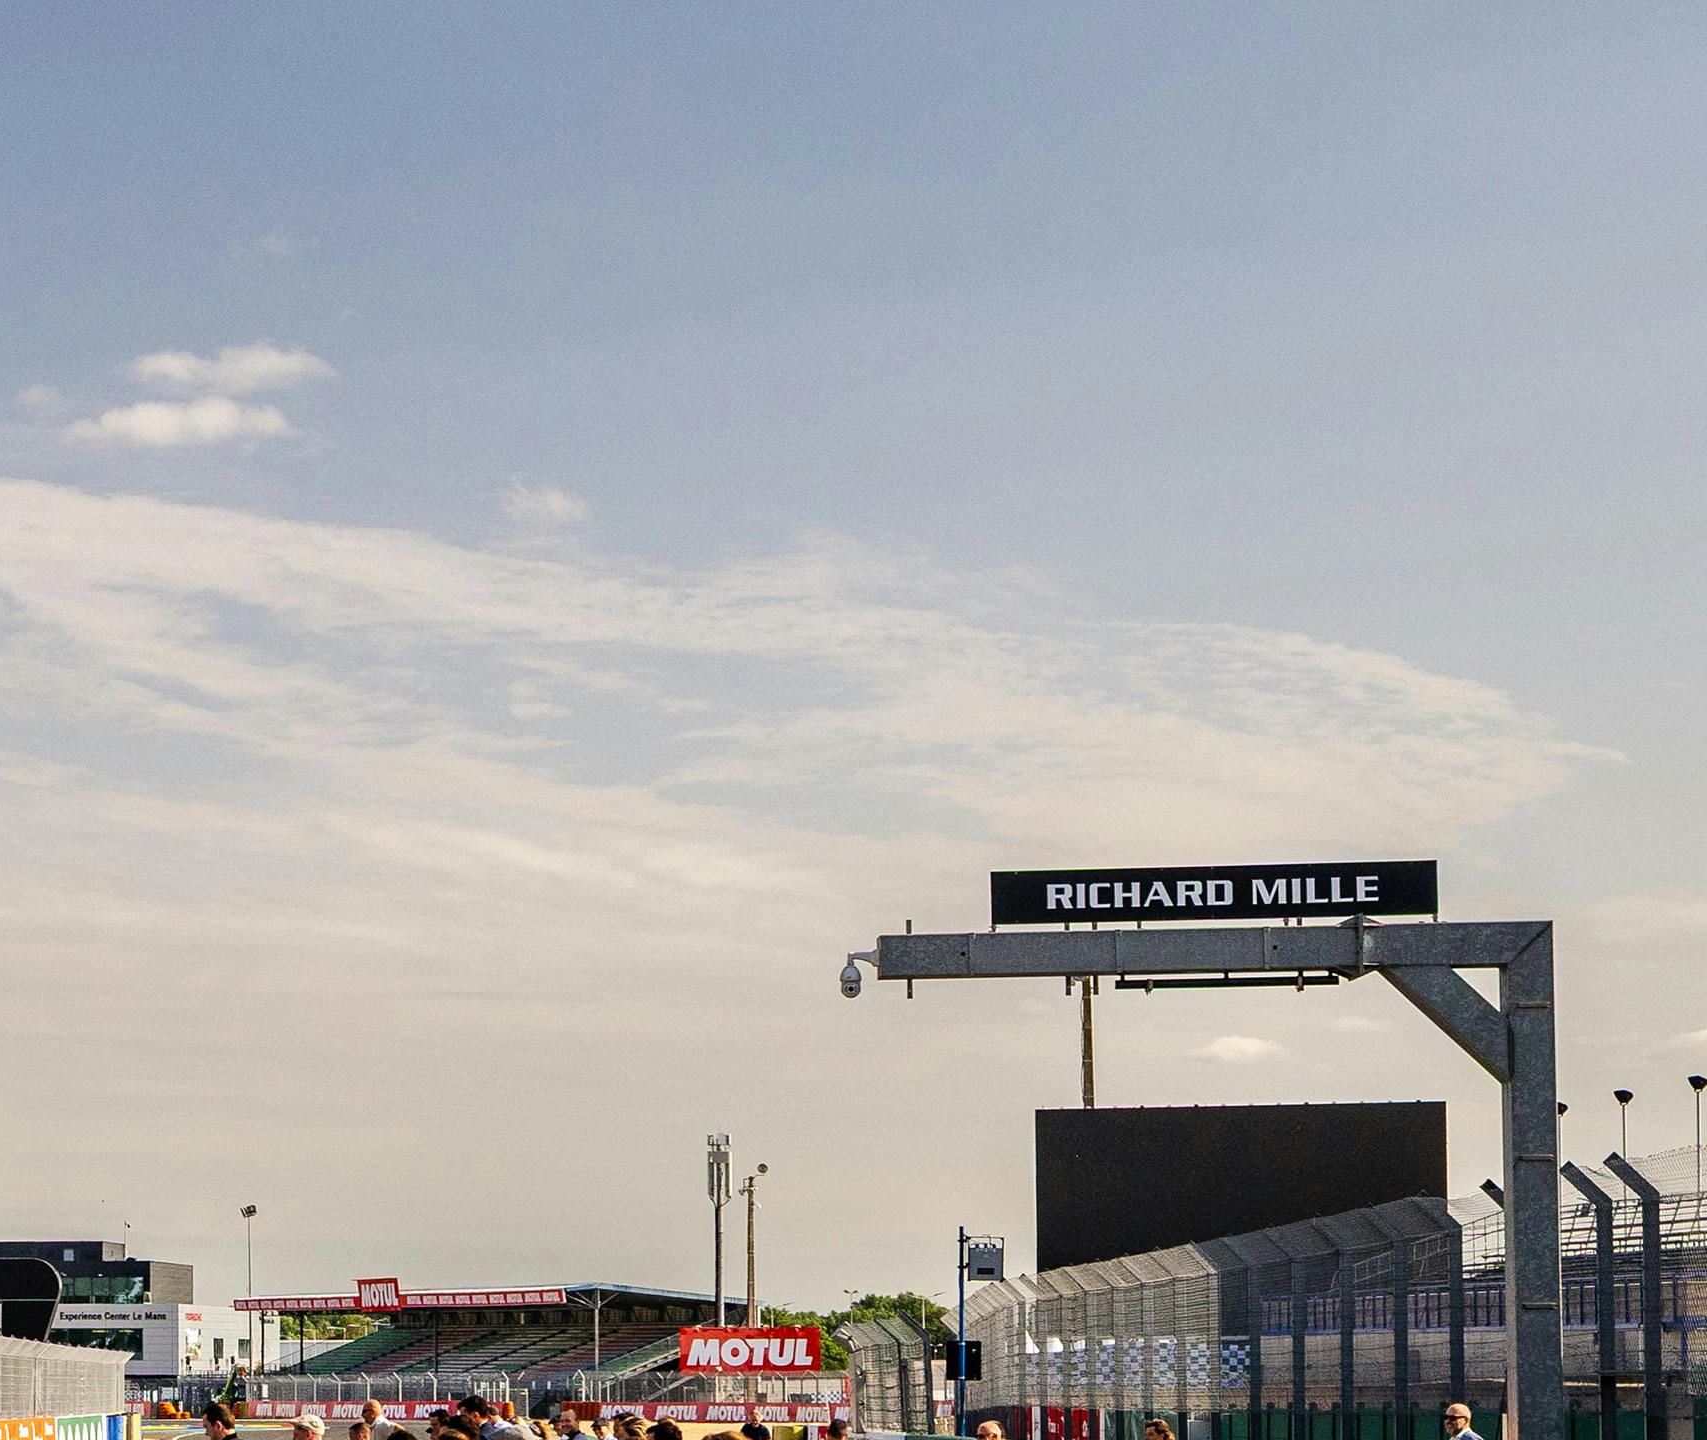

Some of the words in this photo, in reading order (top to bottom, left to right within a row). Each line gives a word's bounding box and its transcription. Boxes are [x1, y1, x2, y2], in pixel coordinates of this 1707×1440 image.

[1046, 880, 1233, 910] RICHARD
[1252, 876, 1379, 905] MILLE
[361, 1283, 398, 1307] MOTUL
[60, 1312, 101, 1321] Experience
[104, 1312, 130, 1320] Center
[133, 1312, 142, 1320] Le
[145, 1312, 166, 1320] Mans
[687, 1338, 813, 1365] MOTUL
[383, 1405, 406, 1418] OTUL
[655, 1406, 697, 1420] MOTUL
[706, 1406, 746, 1421] MOTUL
